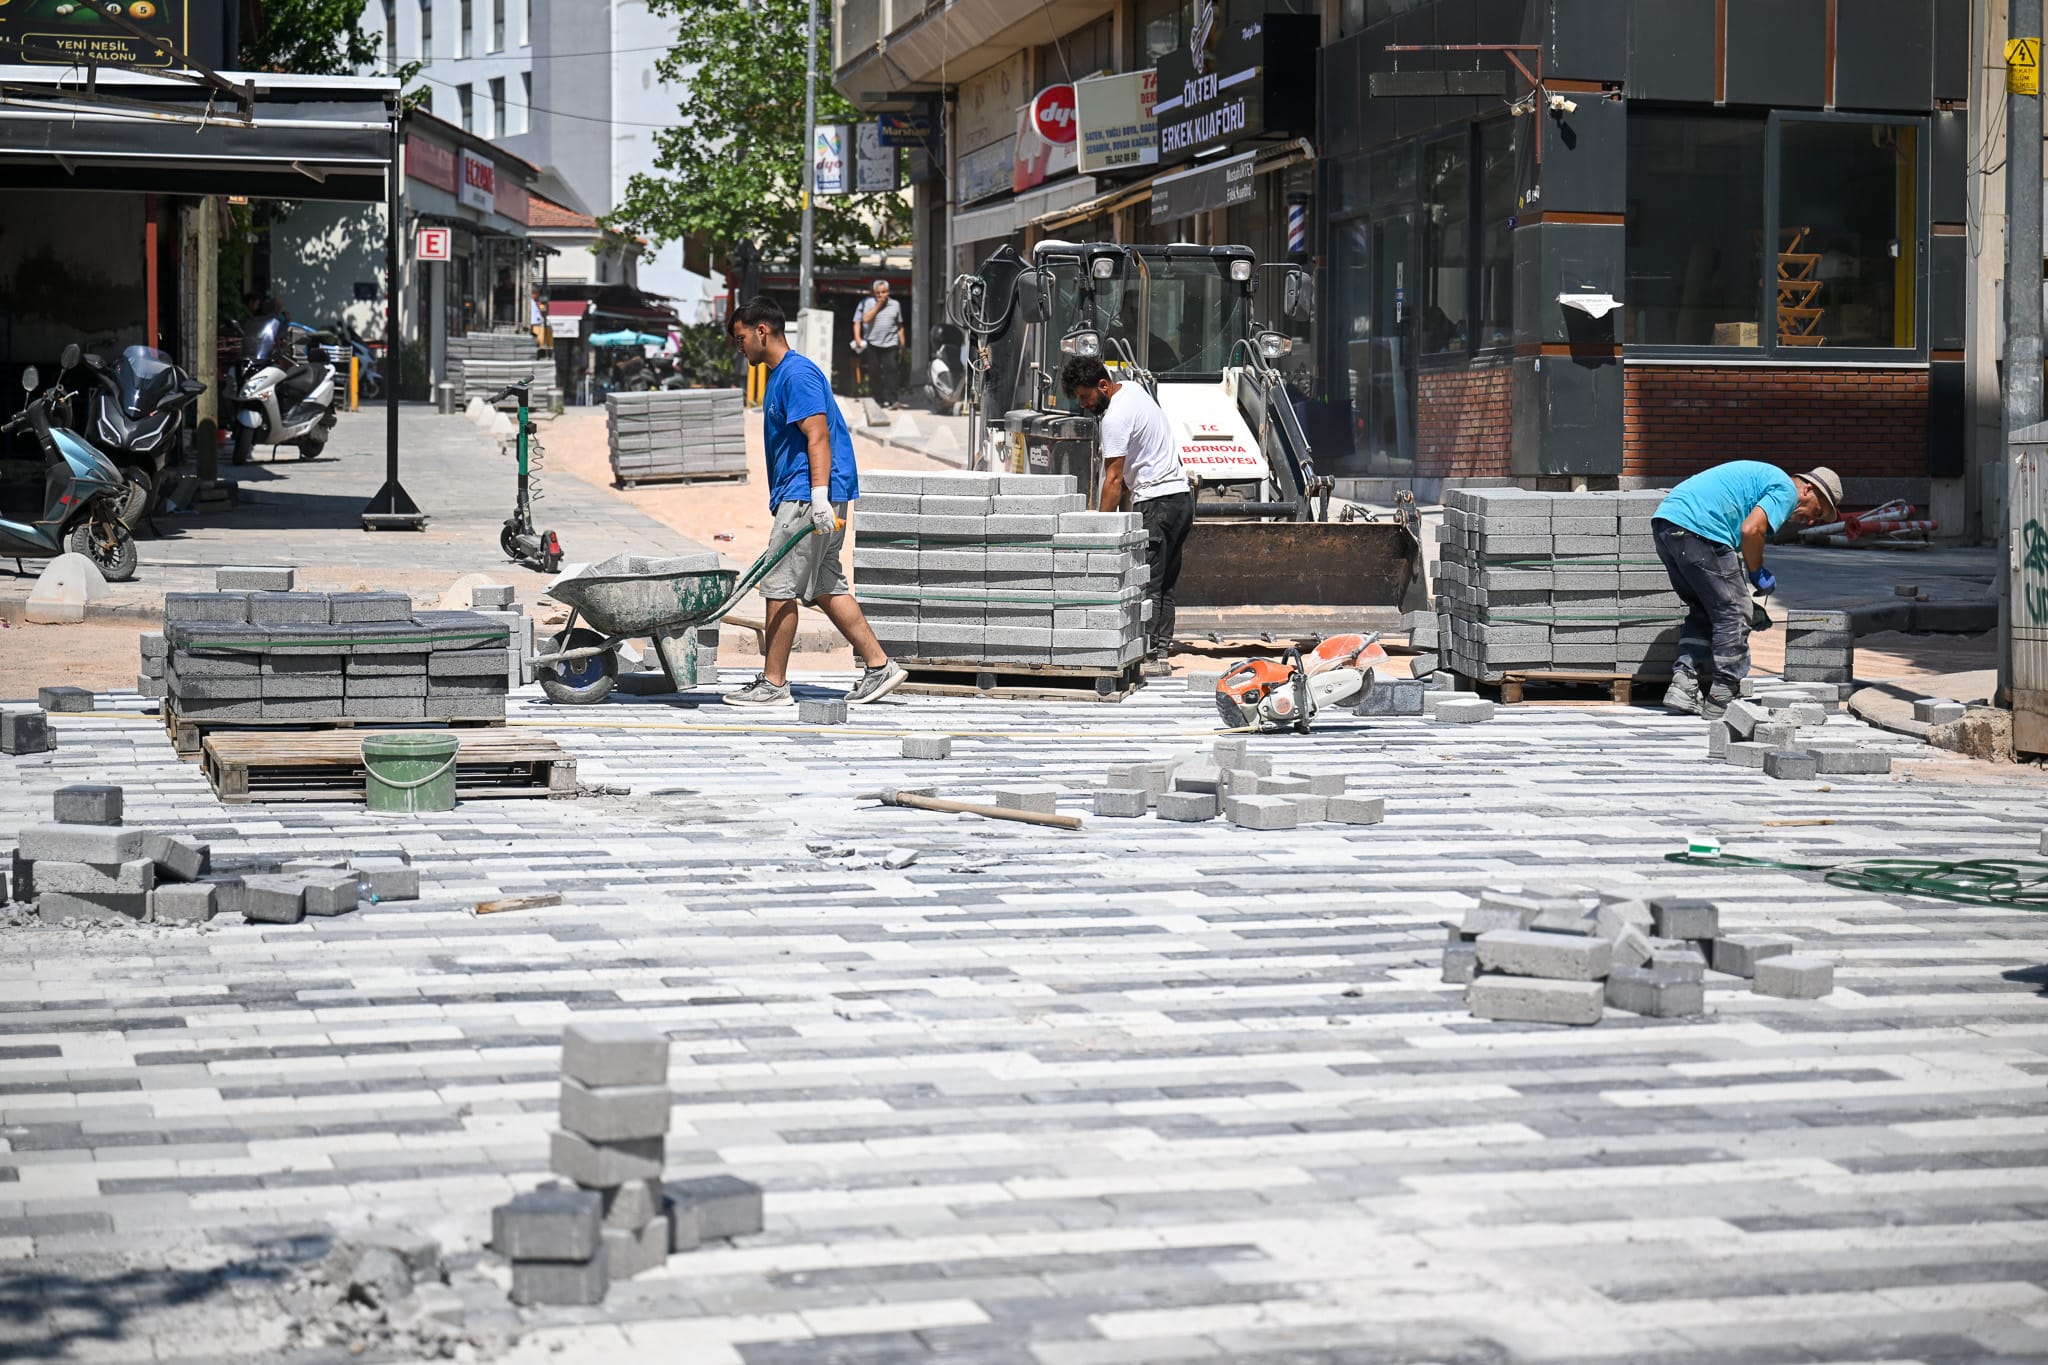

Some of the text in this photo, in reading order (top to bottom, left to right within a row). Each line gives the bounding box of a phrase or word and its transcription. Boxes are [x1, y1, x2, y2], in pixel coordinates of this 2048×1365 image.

[56, 39, 129, 51] YENİ NESİL
[1184, 73, 1217, 108] ÖKTEN
[1162, 97, 1245, 153] ERKEK KUAFÖRÜ
[426, 234, 440, 254] E
[1182, 445, 1247, 453] BORNOVA
[1182, 455, 1258, 465] BELEDİYESİ
